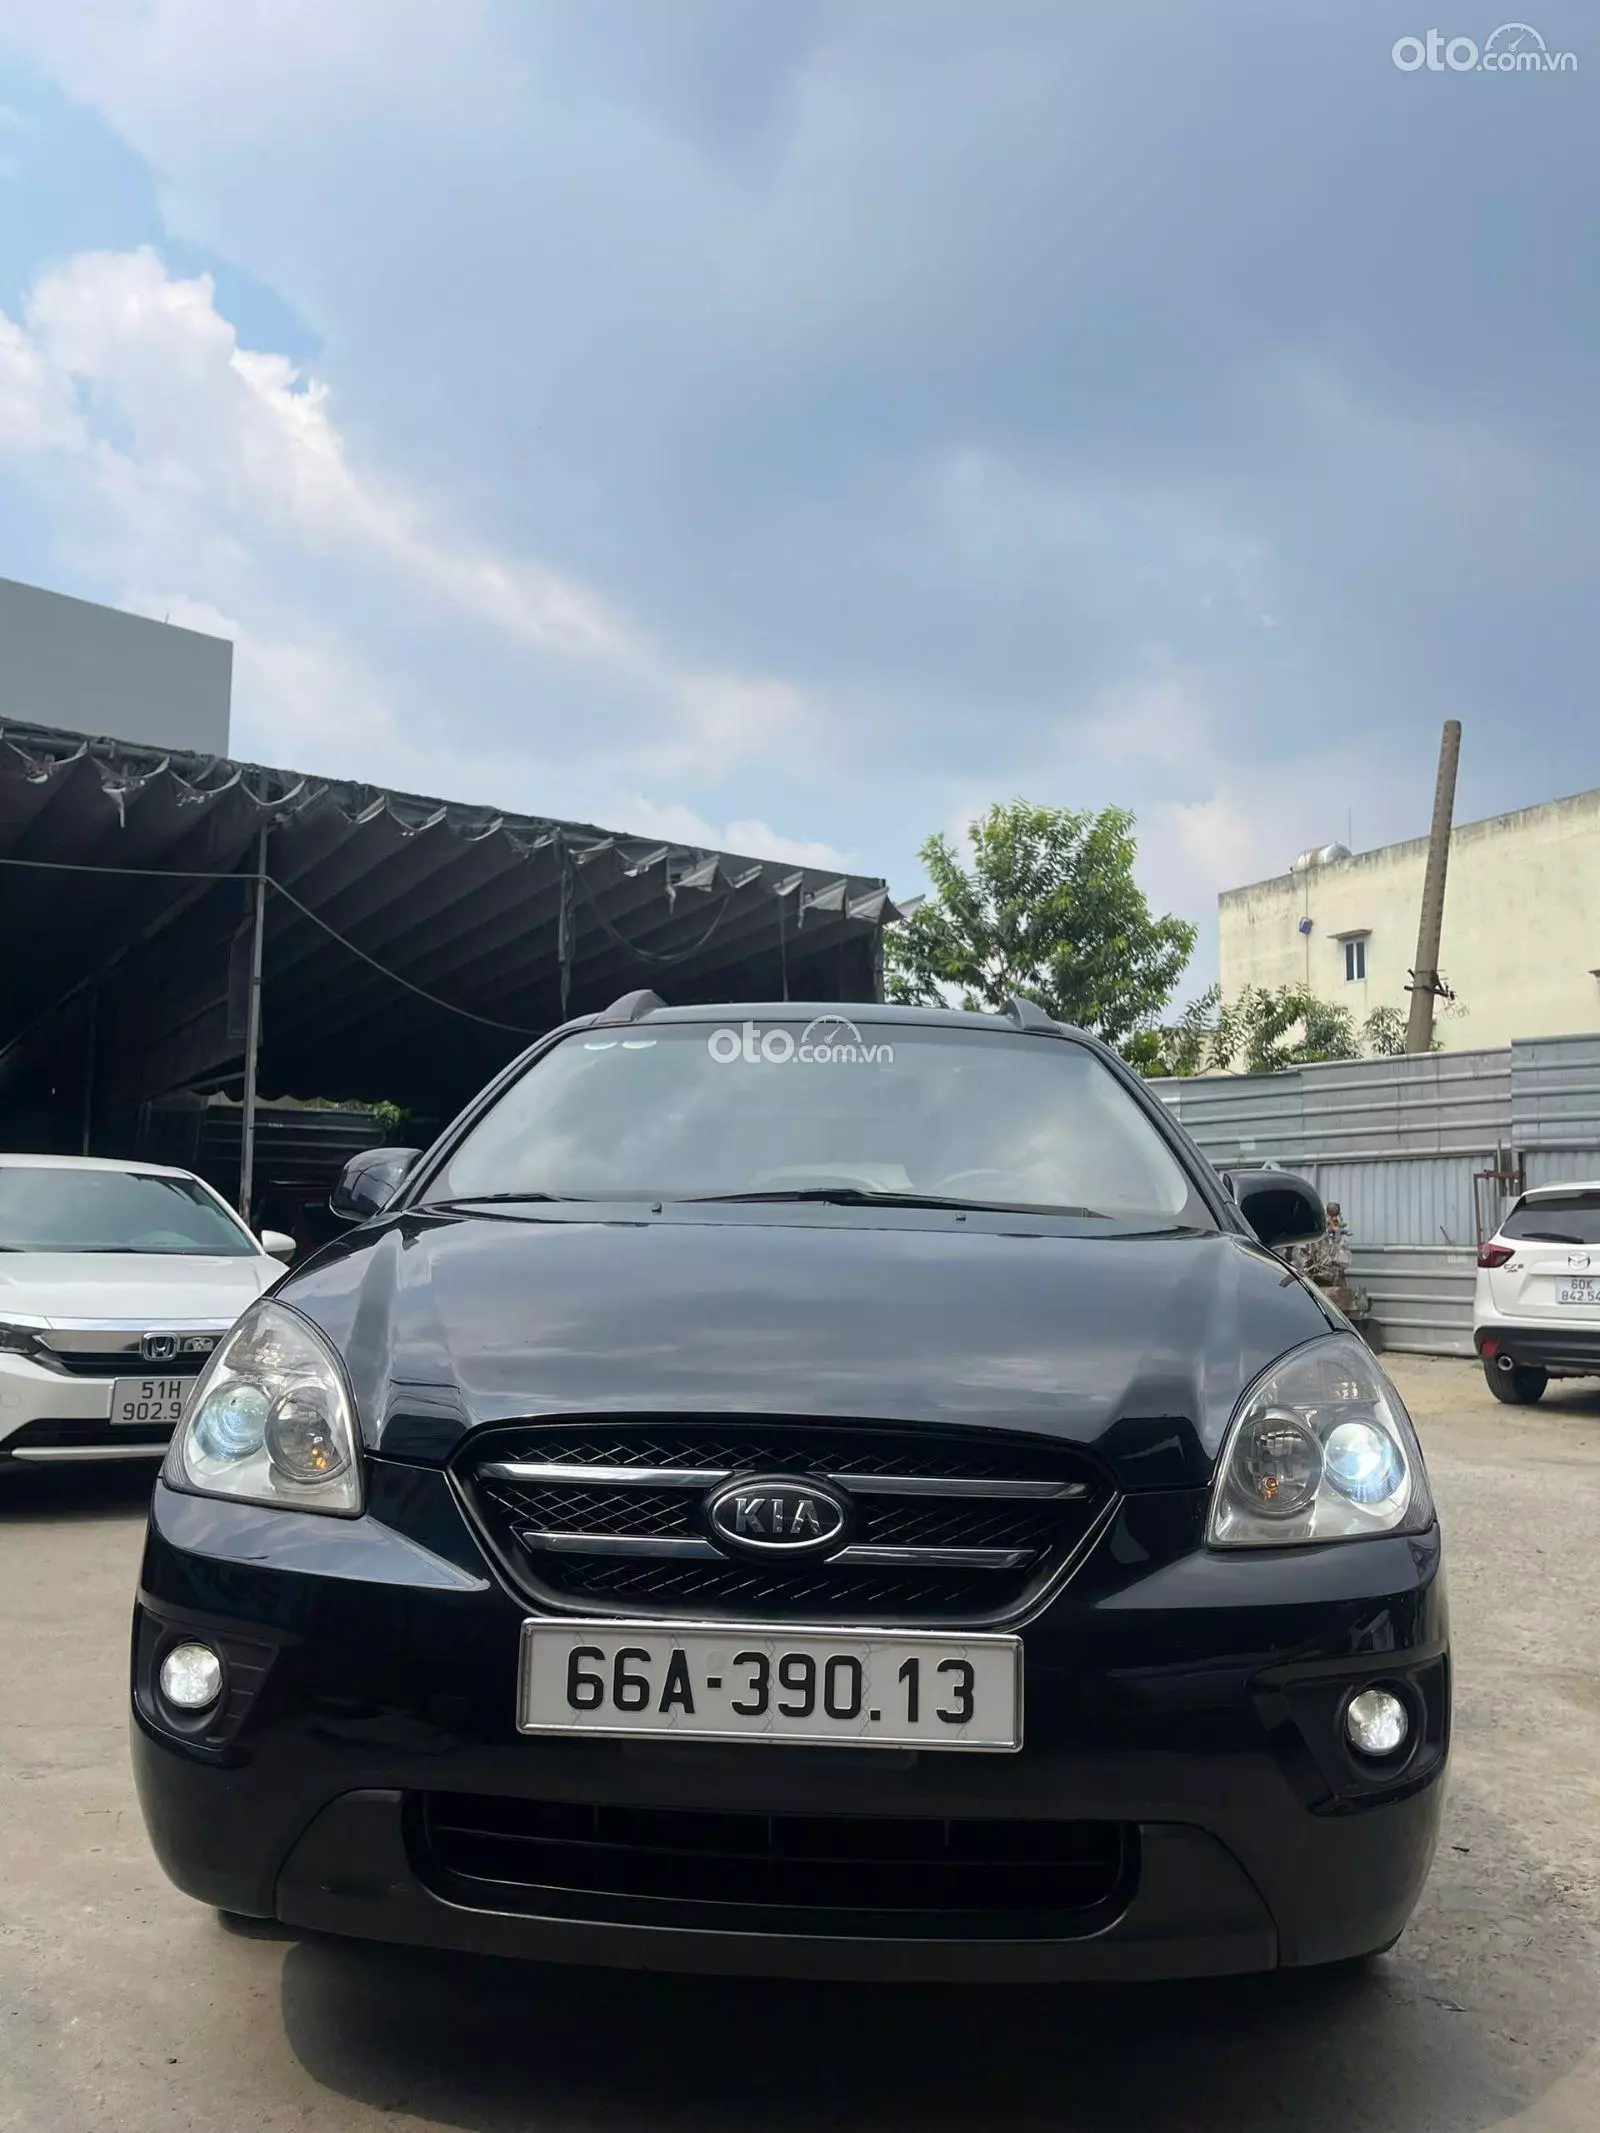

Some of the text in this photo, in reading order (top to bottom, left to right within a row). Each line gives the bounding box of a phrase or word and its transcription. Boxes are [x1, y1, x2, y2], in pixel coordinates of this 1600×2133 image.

[141, 1381, 181, 1399] 51H
[735, 1497, 823, 1535] KIA
[566, 1645, 975, 1725] 66A-390.13
